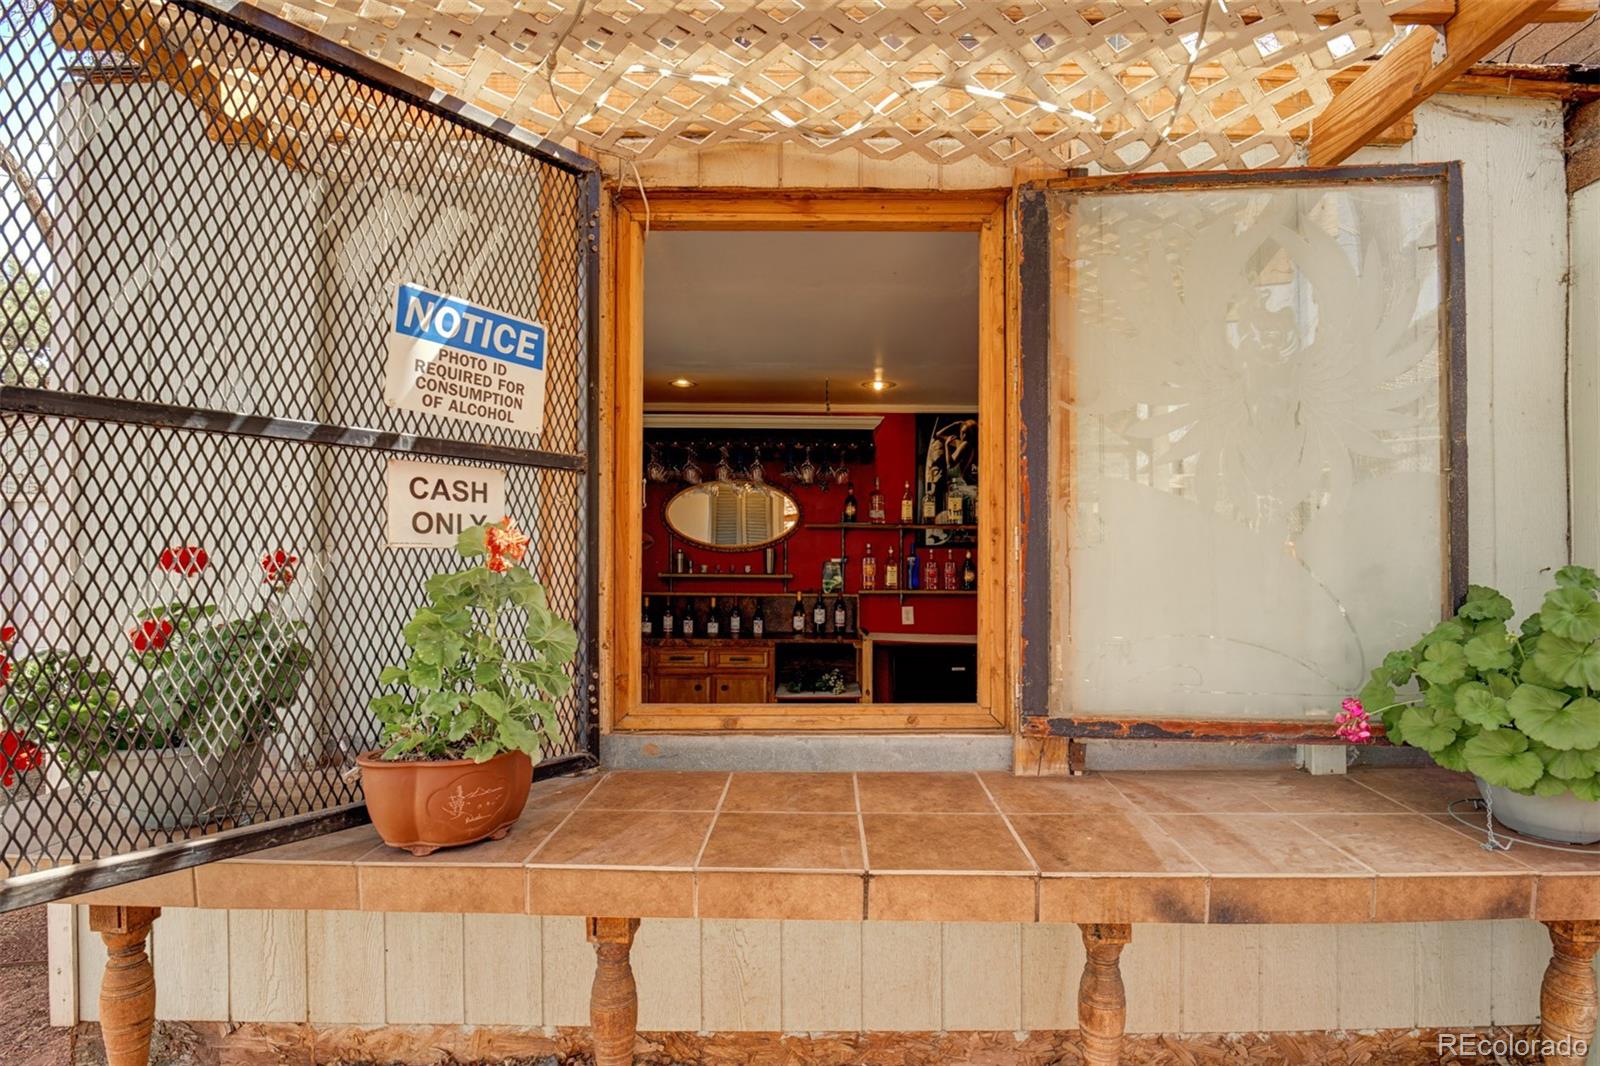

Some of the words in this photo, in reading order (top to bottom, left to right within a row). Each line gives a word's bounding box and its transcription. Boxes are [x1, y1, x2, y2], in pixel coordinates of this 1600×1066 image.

[404, 296, 539, 361] NOTICE
[415, 359, 493, 388] REQUIRED
[498, 379, 525, 396] FOR
[438, 349, 488, 372] PHOTO
[493, 361, 507, 376] ID
[415, 376, 523, 410] CONSUMPTION
[422, 394, 443, 409] OF
[448, 399, 514, 424] ALCOHOL
[409, 476, 488, 504] CASH
